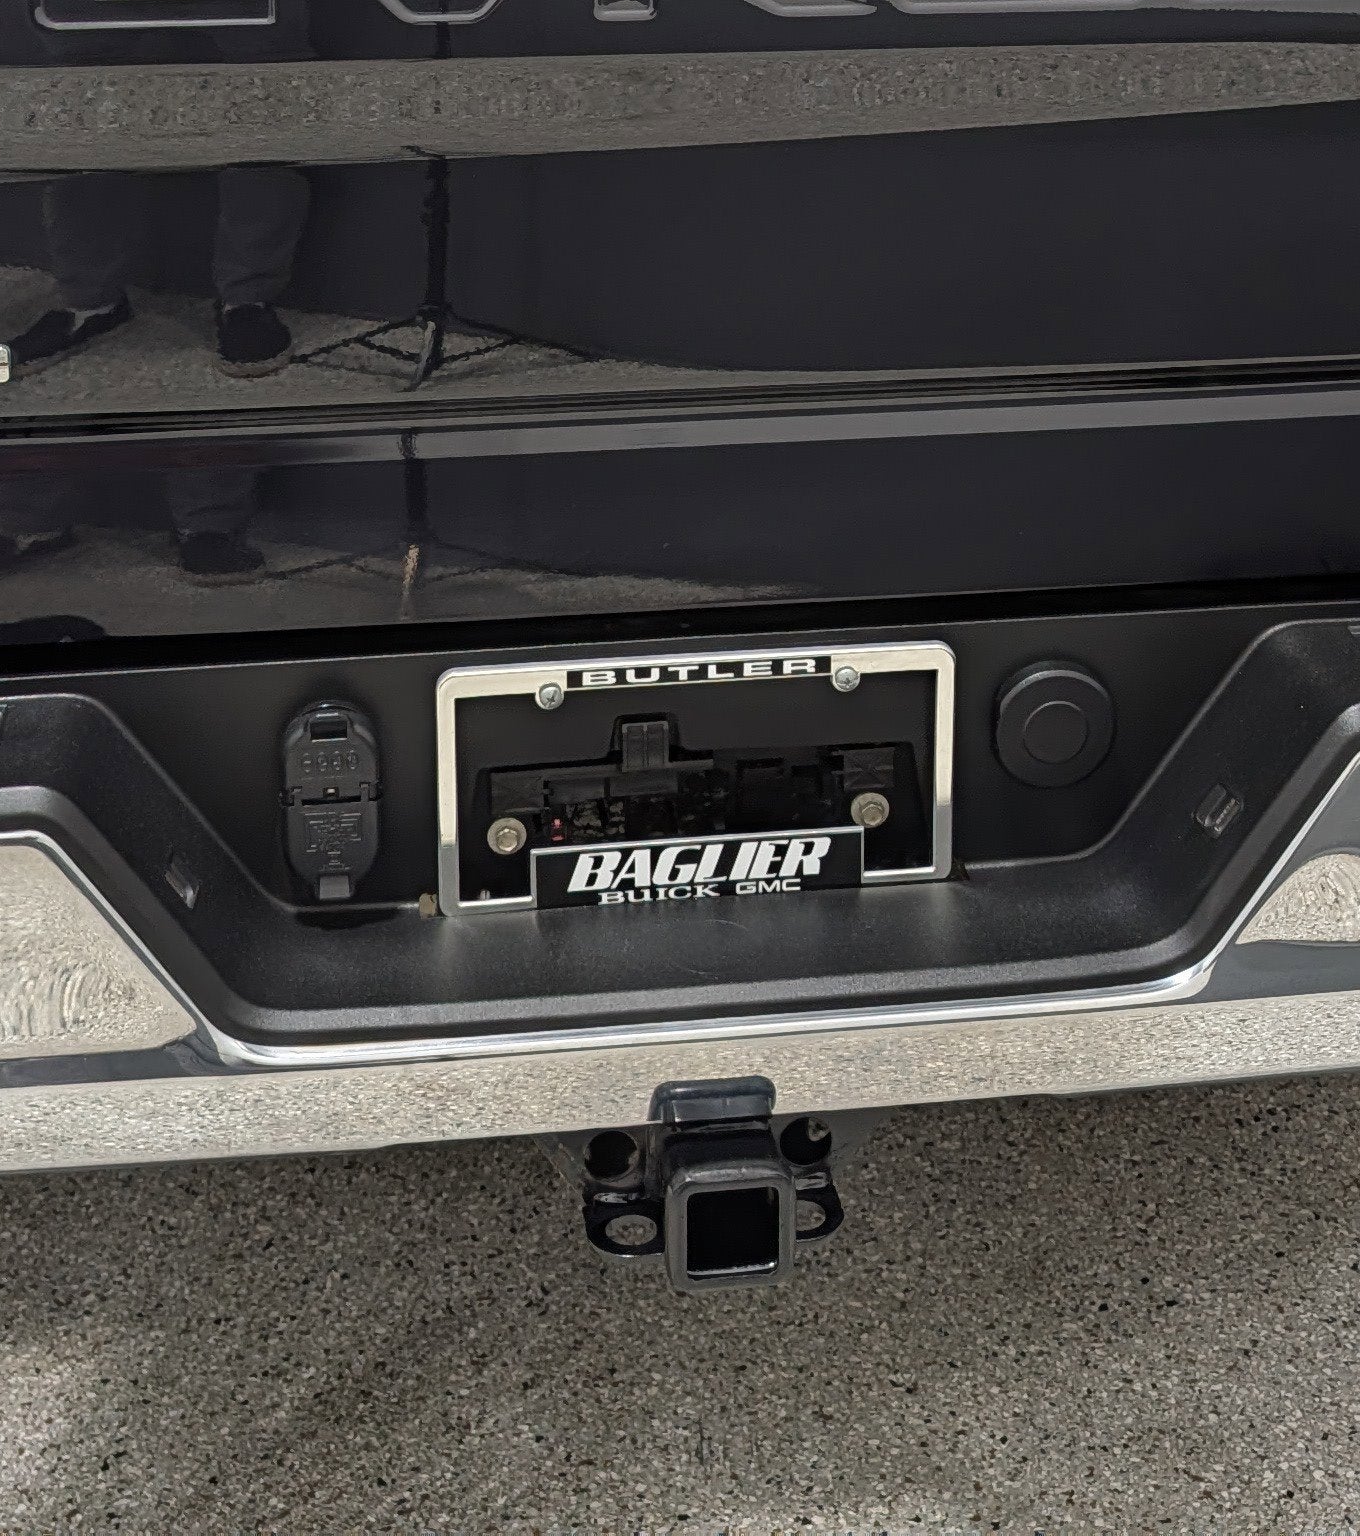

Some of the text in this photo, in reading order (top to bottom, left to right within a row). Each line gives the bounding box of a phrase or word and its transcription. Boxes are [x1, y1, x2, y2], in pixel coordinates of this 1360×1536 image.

[581, 659, 817, 687] BUTLER
[567, 836, 832, 892] BAGLIER
[598, 878, 802, 905] BUICK GMC
